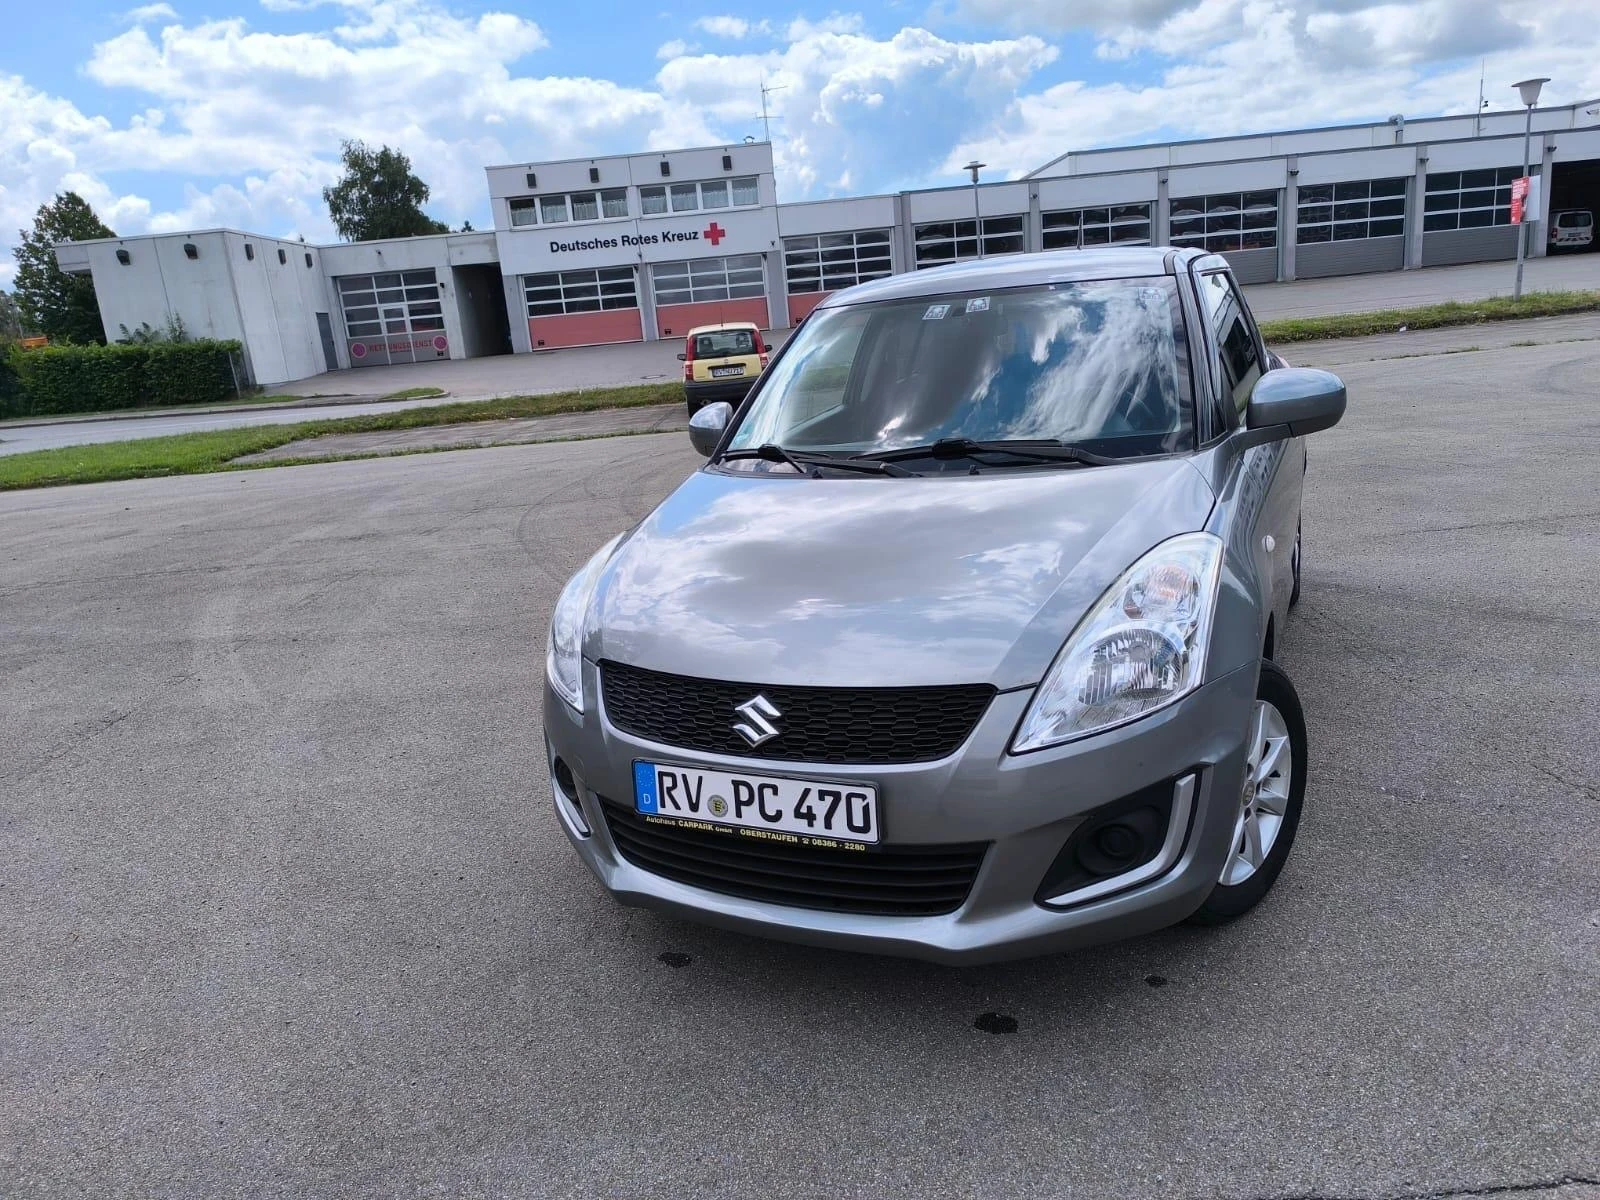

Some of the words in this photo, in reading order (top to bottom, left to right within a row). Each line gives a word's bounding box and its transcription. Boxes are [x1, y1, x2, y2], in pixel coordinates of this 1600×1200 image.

[550, 237, 618, 253] Deutsches
[621, 235, 659, 247] Rotes
[662, 230, 699, 243] Kreuz
[643, 793, 651, 804] D
[658, 771, 703, 813] RV
[731, 779, 783, 823] PC
[794, 788, 871, 834] 470
[646, 816, 676, 826] Autohaus
[678, 820, 714, 831] CARPARK
[715, 826, 733, 834] GmbH
[740, 828, 798, 843] OBERSTAUFEN
[812, 838, 837, 848] 08386
[844, 842, 865, 851] 2280
